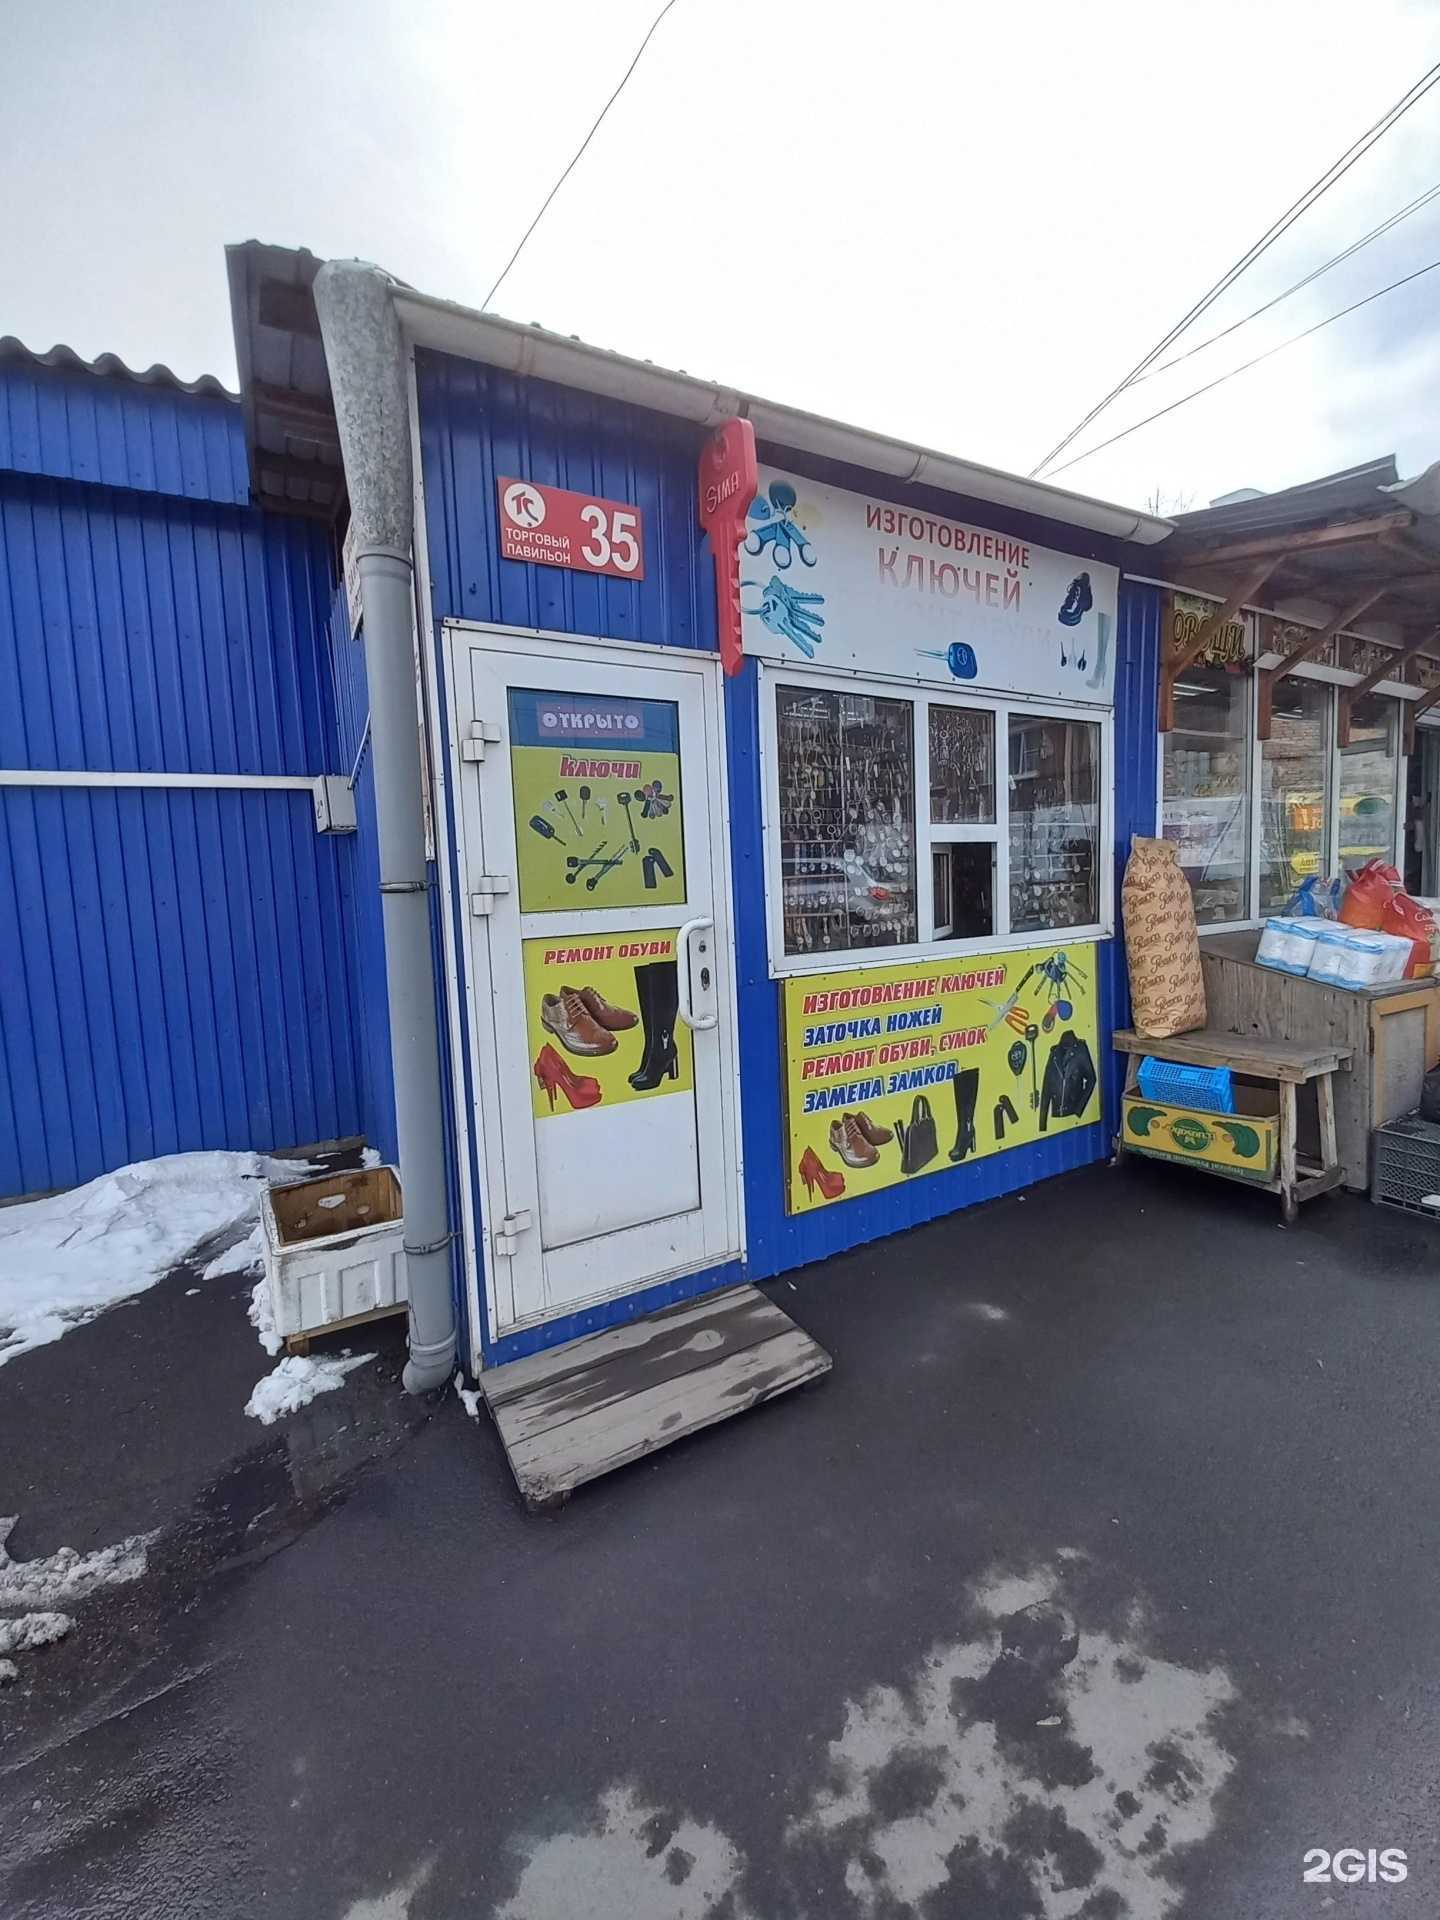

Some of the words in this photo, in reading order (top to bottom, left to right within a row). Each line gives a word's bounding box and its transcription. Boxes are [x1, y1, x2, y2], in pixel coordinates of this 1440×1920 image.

[706, 471, 739, 512] SIMA
[506, 527, 571, 549] ТОРГОВЫЙ
[507, 543, 571, 565] ПАВИЛЬОН
[579, 504, 640, 572] 35
[866, 503, 1031, 569] ИЗГОТОВЛЕНИЕ
[878, 547, 1021, 612] КЛЮЧЕЙ
[542, 712, 640, 730] ОТКРЫТО
[560, 754, 642, 779] КЛЮЧИ
[544, 943, 615, 965] РЕМОНТ
[618, 940, 672, 957] ОБУВИ
[803, 980, 936, 1015] ИЗГОТОВЛЕНИЕ
[940, 966, 1005, 993] КЛЮЧЕЙ
[803, 1018, 881, 1047] ЗАТОЧКА
[886, 1004, 942, 1030] НОЖЕЙ
[802, 1050, 876, 1079] РЕМОНТ
[879, 1038, 935, 1064] ОБУВИ,
[939, 1027, 988, 1051] СУМОК
[803, 1078, 883, 1112] ЗАМЕНА
[887, 1062, 957, 1093] ЗАМКОВ
